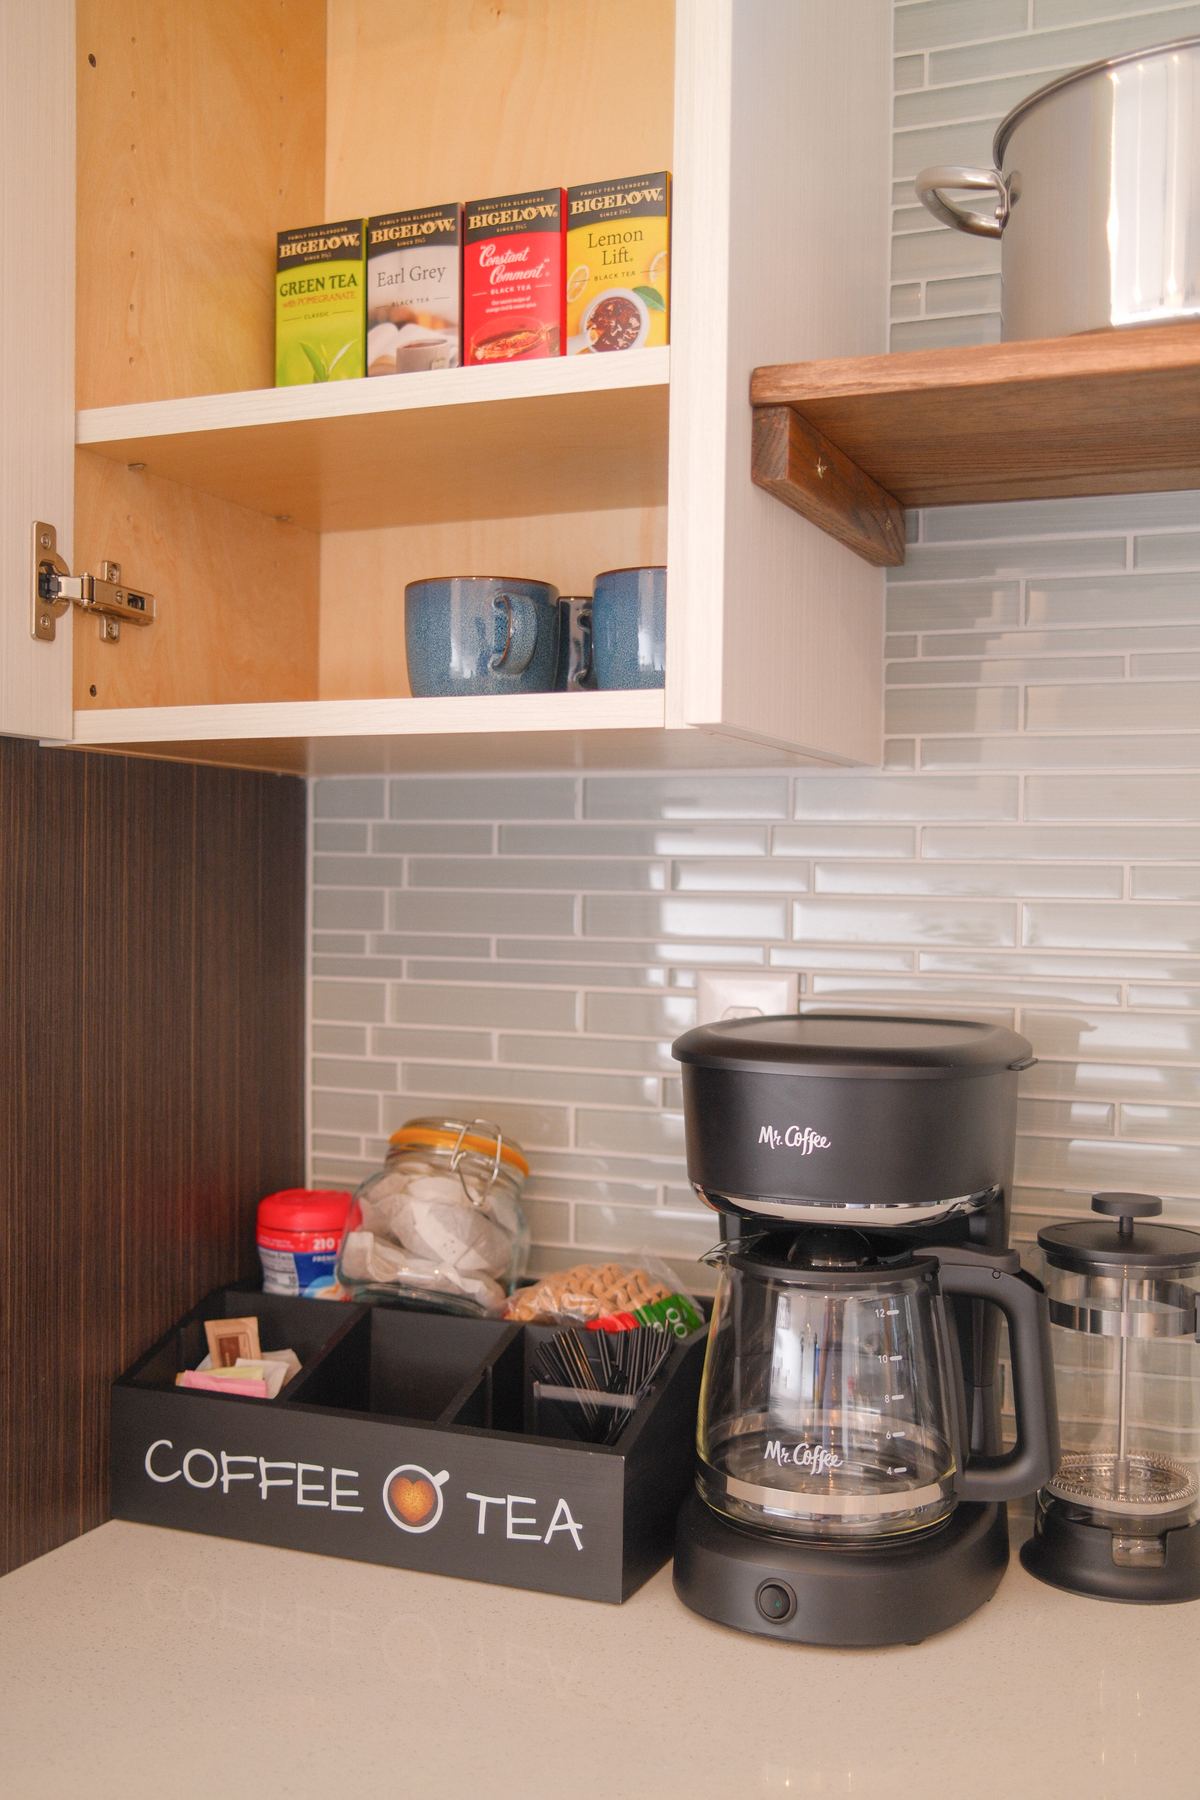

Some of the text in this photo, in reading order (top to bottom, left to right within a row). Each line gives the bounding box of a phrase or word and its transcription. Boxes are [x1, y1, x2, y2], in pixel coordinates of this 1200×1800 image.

[617, 181, 649, 190] BLENDERS
[570, 187, 663, 215] BIGELOW
[468, 204, 558, 229] BIGELOW
[370, 218, 456, 245] BIGELOW
[587, 229, 644, 249] Lemon
[279, 233, 360, 258] BIGELOW
[602, 246, 630, 266] Lift
[280, 273, 358, 297] GREEN TEA
[377, 265, 447, 288] Earl Grey
[594, 270, 636, 281] BLACK TEA
[490, 287, 514, 295] BLACK
[758, 1125, 832, 1156] Mr. Coffee
[313, 1237, 335, 1251] 210
[874, 1309, 886, 1318] 12
[878, 1355, 888, 1364] 10
[884, 1395, 890, 1403] 8
[885, 1431, 892, 1439] 6
[763, 1440, 844, 1475] Mr. Coffee
[886, 1467, 893, 1475] 4
[144, 1439, 583, 1551] COFFEE TEA
